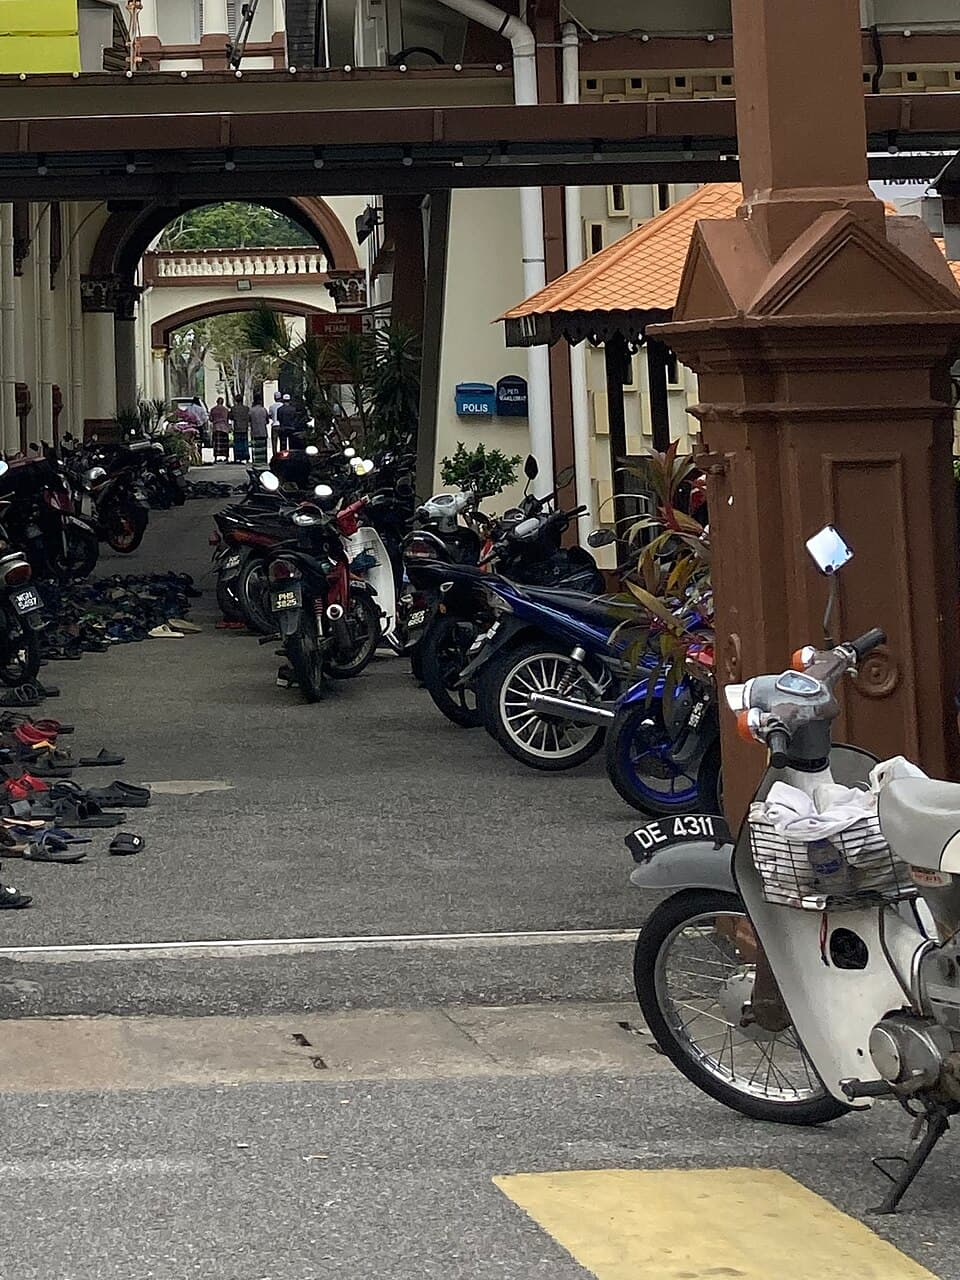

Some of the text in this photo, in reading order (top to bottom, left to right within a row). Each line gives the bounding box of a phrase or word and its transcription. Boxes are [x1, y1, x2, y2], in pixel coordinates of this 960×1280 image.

[462, 403, 489, 413] POLIS
[634, 816, 714, 849] DE 4311
